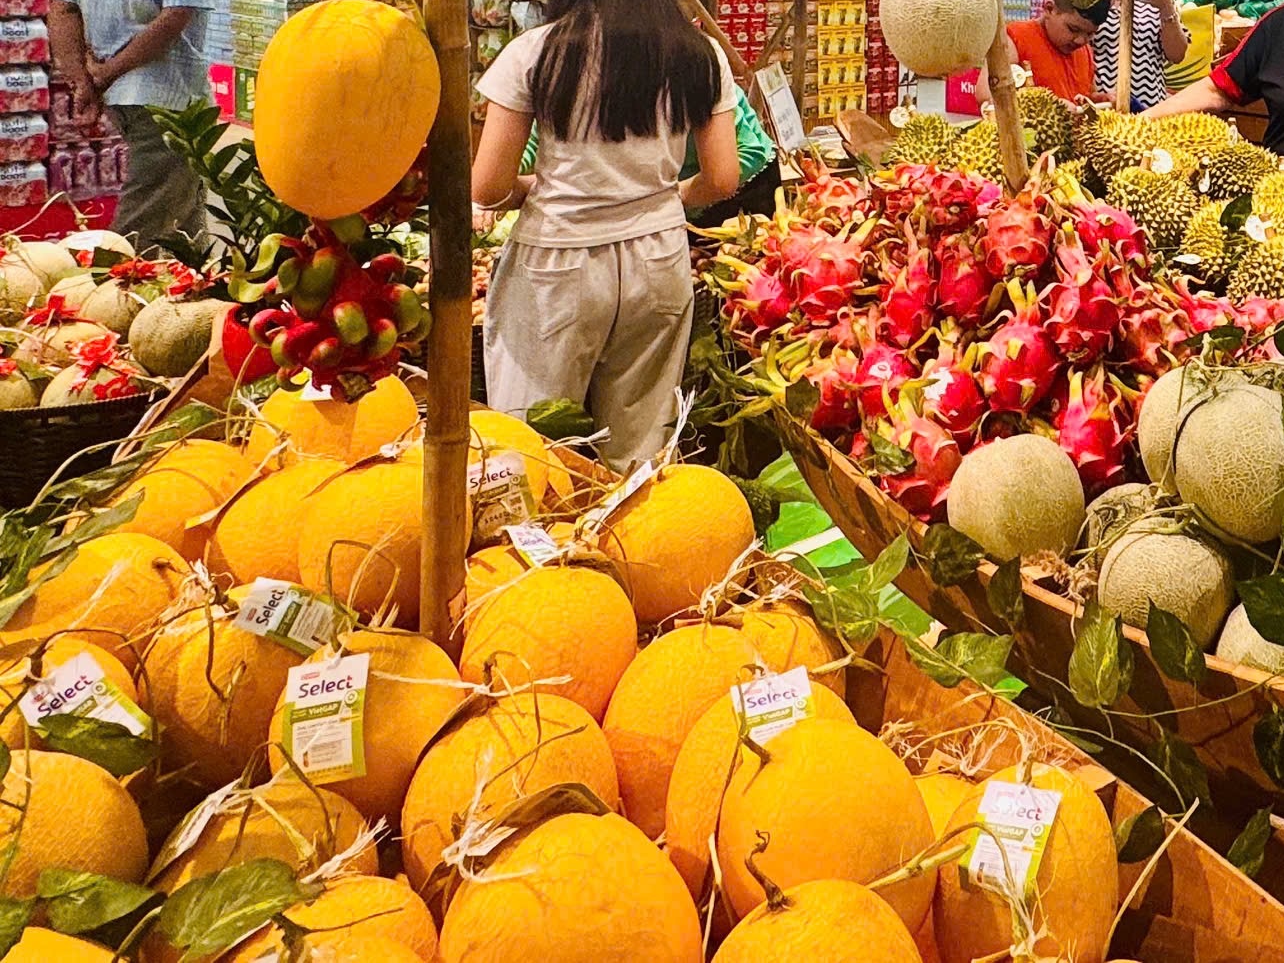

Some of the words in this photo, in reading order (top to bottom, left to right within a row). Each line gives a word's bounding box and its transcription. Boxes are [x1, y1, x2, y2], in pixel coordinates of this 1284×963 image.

[468, 466, 513, 489] Select
[255, 589, 286, 627] Select
[297, 675, 354, 699] Select
[746, 688, 799, 709] Select
